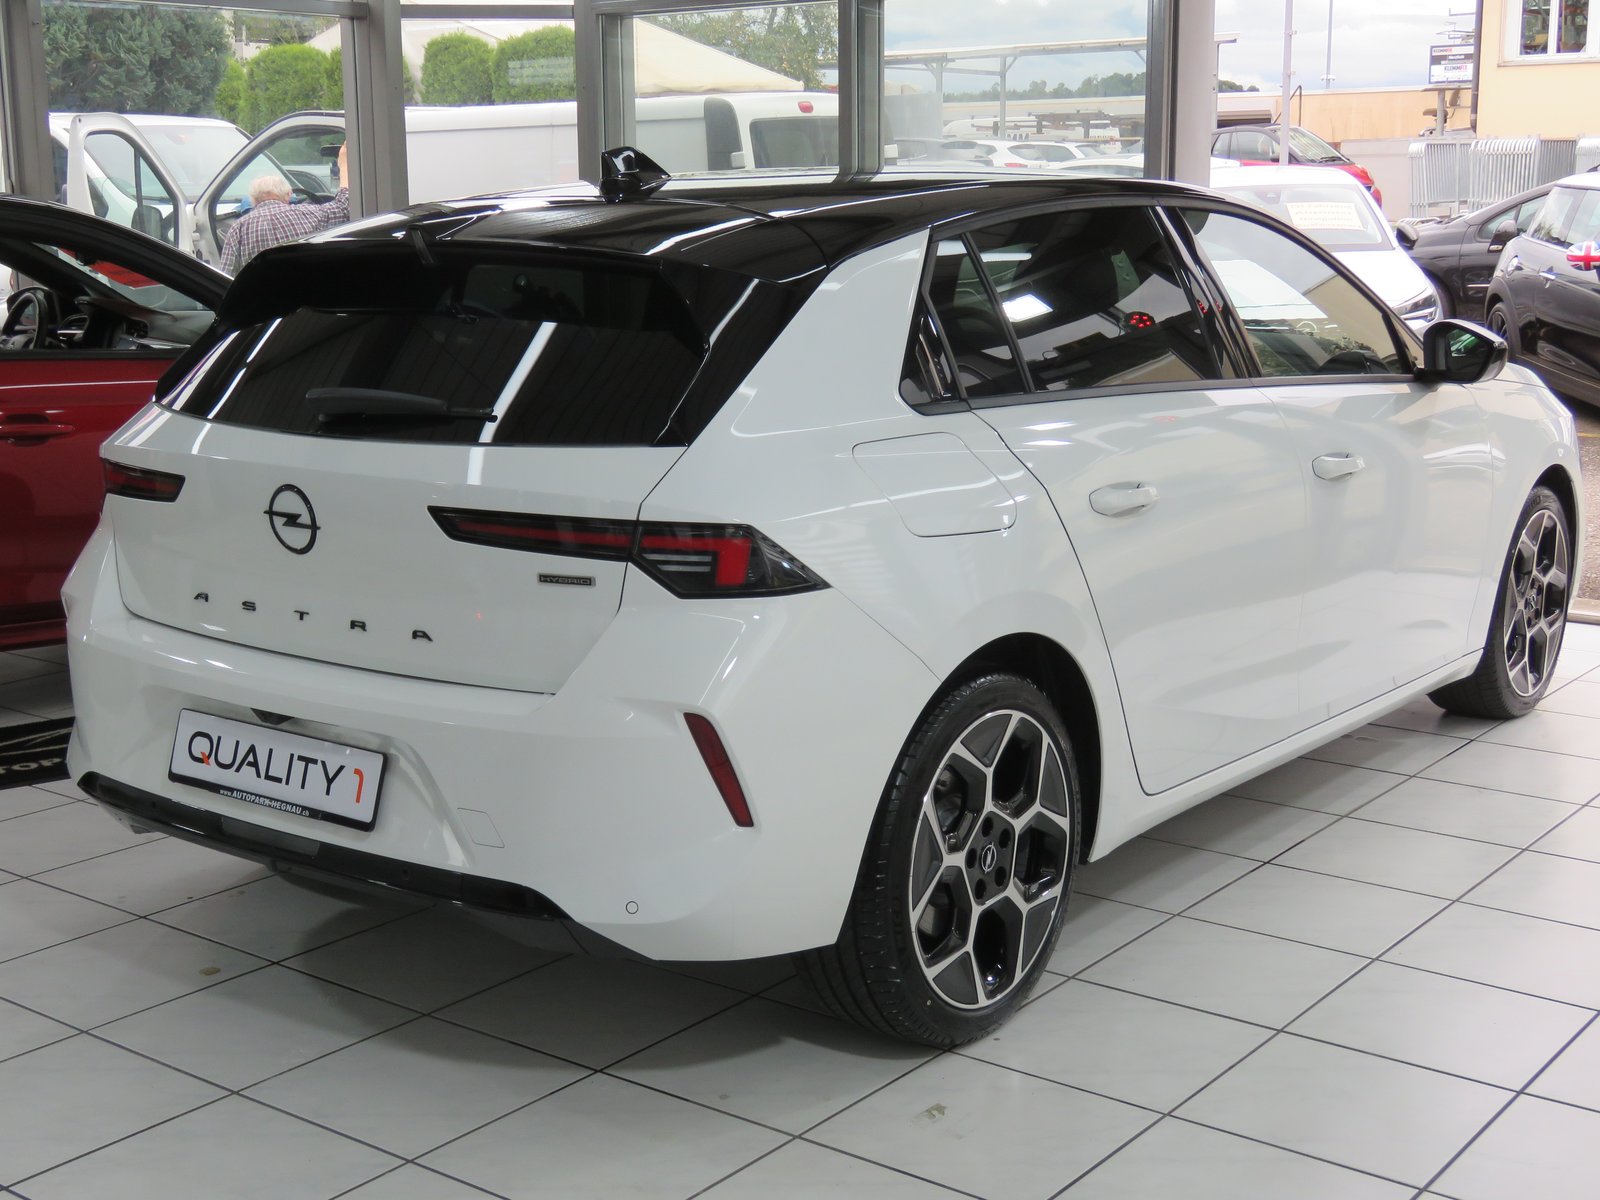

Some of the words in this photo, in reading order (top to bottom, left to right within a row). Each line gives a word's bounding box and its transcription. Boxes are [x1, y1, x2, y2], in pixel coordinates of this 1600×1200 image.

[540, 575, 590, 585] HYBRID
[193, 591, 434, 642] ASTRA
[187, 730, 346, 796] QUALITY
[353, 767, 365, 804] 1
[219, 788, 310, 817] www.AUTOPARK-HEGNAU.ch
